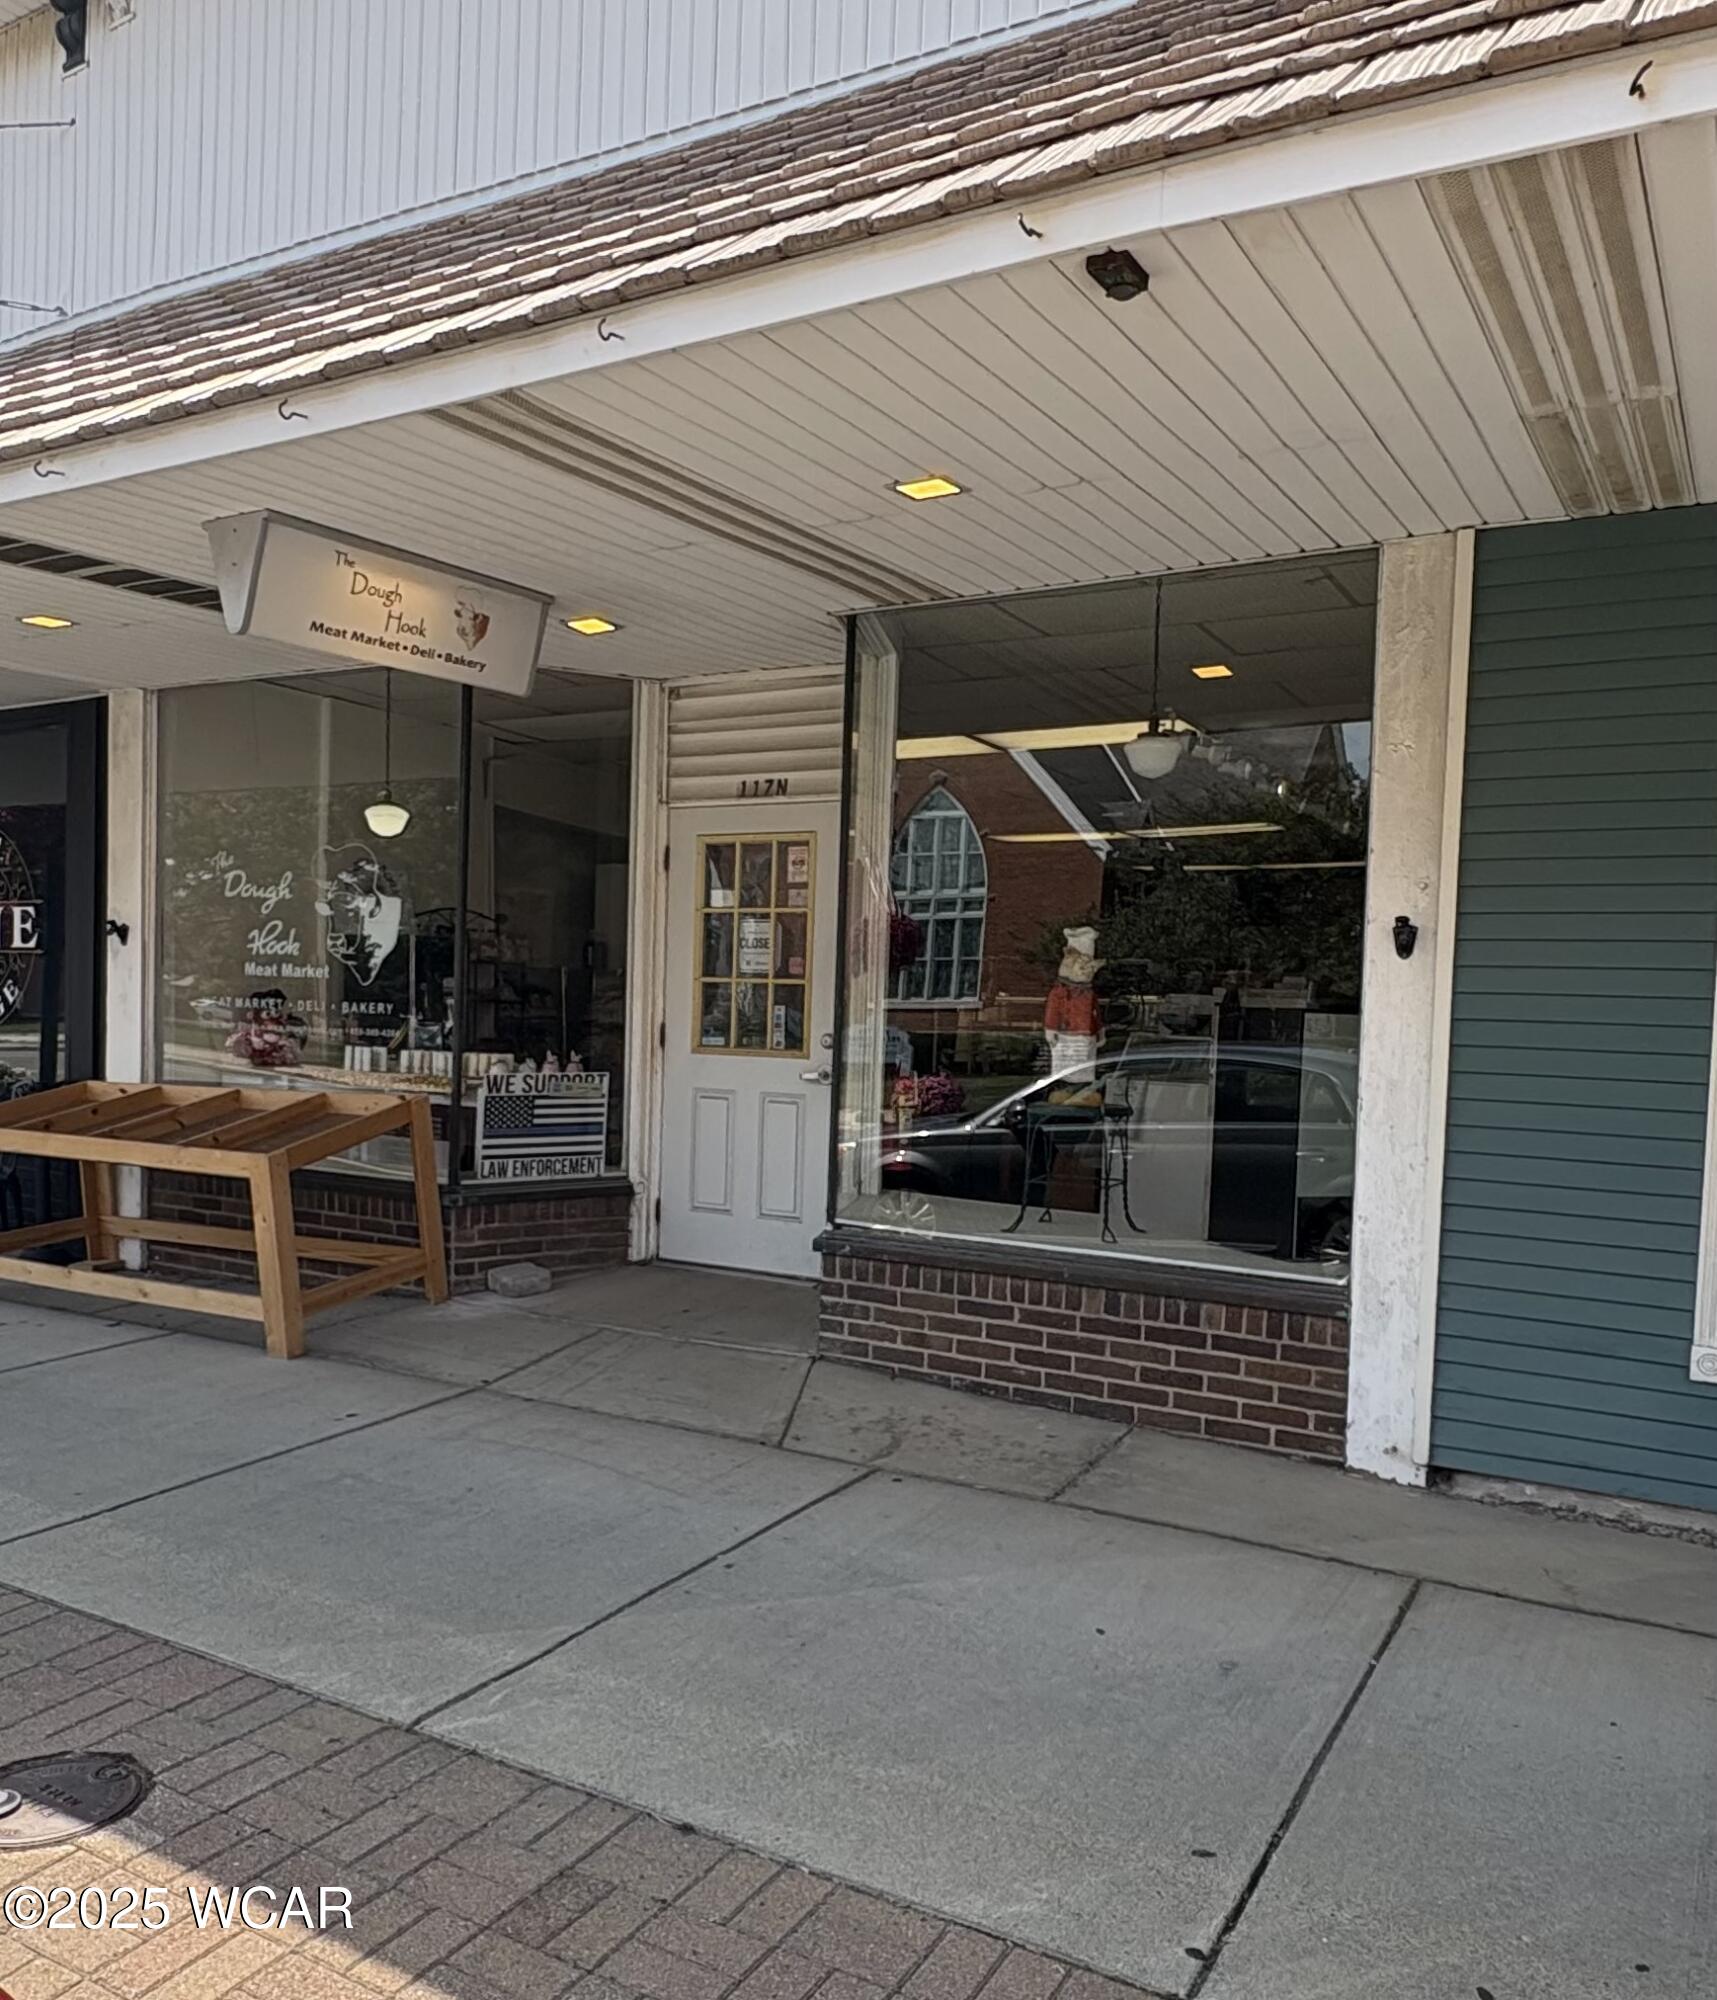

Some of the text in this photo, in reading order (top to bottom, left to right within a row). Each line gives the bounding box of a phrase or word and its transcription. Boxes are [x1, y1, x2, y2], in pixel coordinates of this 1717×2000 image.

[334, 549, 356, 568] The
[350, 571, 403, 608] Dough
[384, 609, 427, 638] Hook
[309, 620, 487, 672] Meat Market Deli Bakery
[210, 851, 235, 874] The
[223, 869, 293, 914] Dough
[246, 920, 301, 956] Hook
[244, 962, 330, 978] Meat Market
[235, 997, 283, 1010] MARKET
[341, 1001, 394, 1015] BAKERY
[486, 1074, 516, 1094] WE
[480, 1156, 603, 1179] LAW ENFORCEMENT
